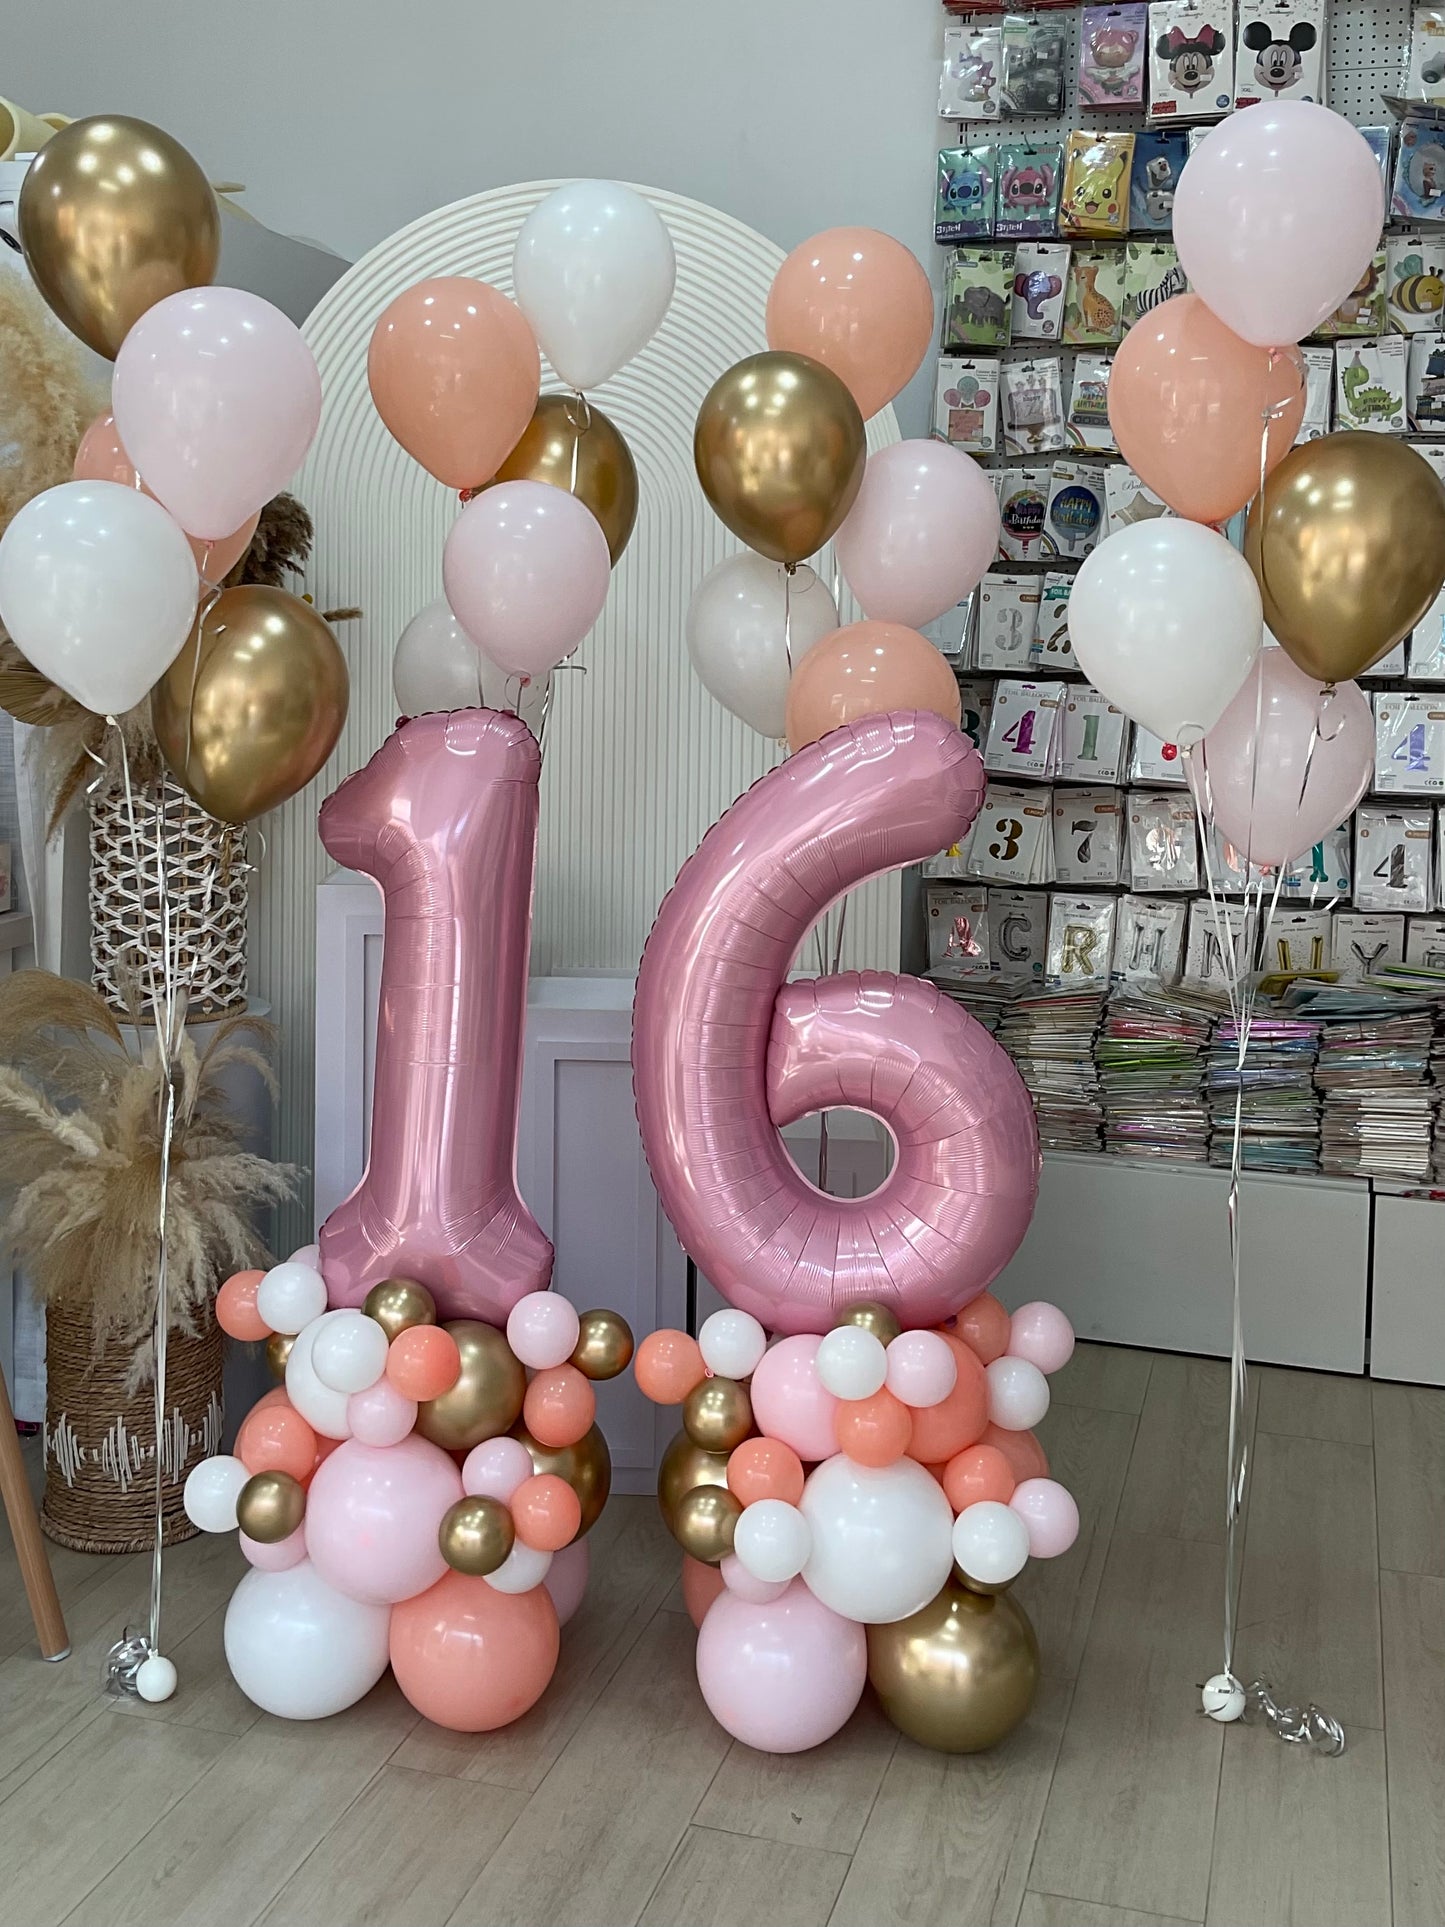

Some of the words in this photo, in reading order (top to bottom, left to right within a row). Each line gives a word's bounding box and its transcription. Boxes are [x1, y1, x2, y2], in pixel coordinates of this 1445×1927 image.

[1060, 497, 1092, 513] HAPPY
[995, 607, 1023, 651] 3
[1001, 709, 1036, 755] 4
[1077, 714, 1100, 760] 1
[1391, 723, 1430, 772] 4
[988, 818, 1024, 861] 3
[1071, 820, 1099, 864] 7
[1373, 844, 1408, 889] 4
[941, 916, 983, 958] A
[1000, 911, 1033, 962] C
[1061, 923, 1098, 976] R
[1128, 921, 1168, 974] H
[1351, 940, 1389, 981] Y
